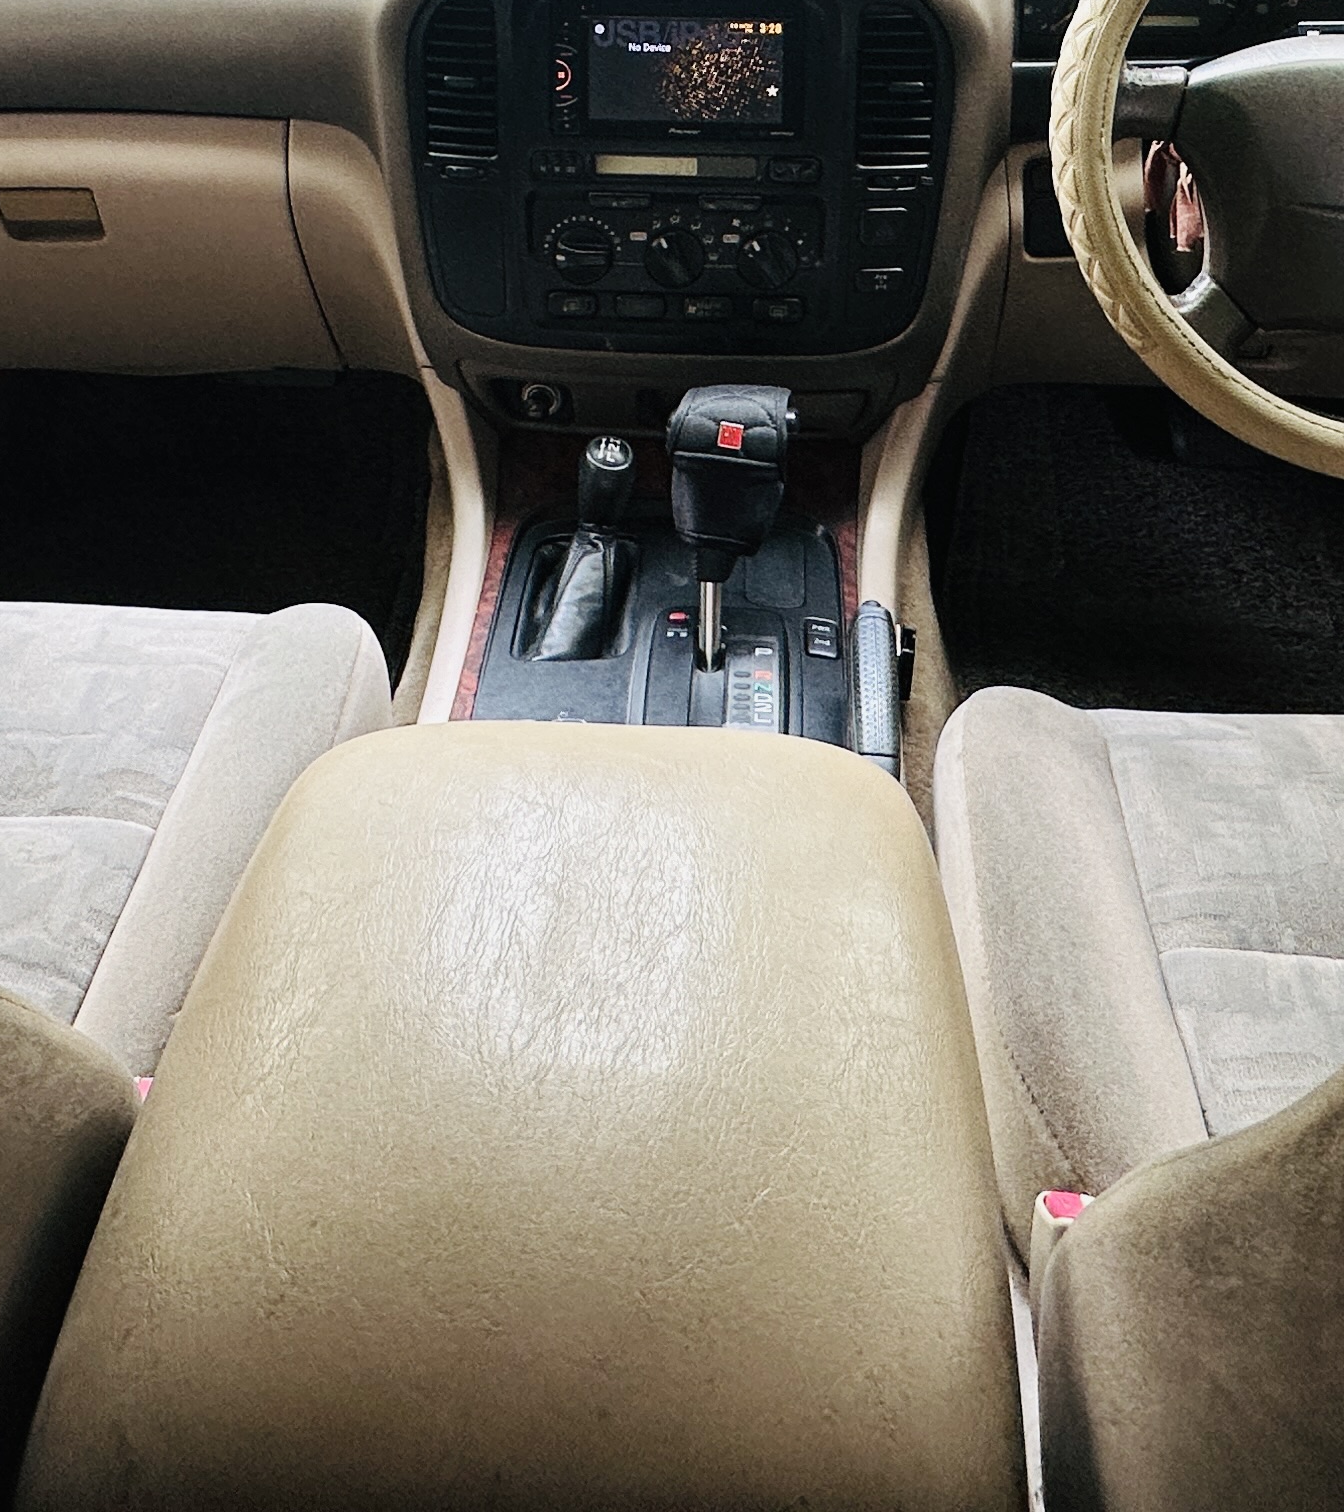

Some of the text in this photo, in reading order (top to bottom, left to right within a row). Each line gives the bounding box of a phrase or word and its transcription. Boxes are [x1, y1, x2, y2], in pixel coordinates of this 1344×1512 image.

[628, 42, 671, 53] No Device
[755, 647, 773, 657] P
[754, 693, 773, 703] D
